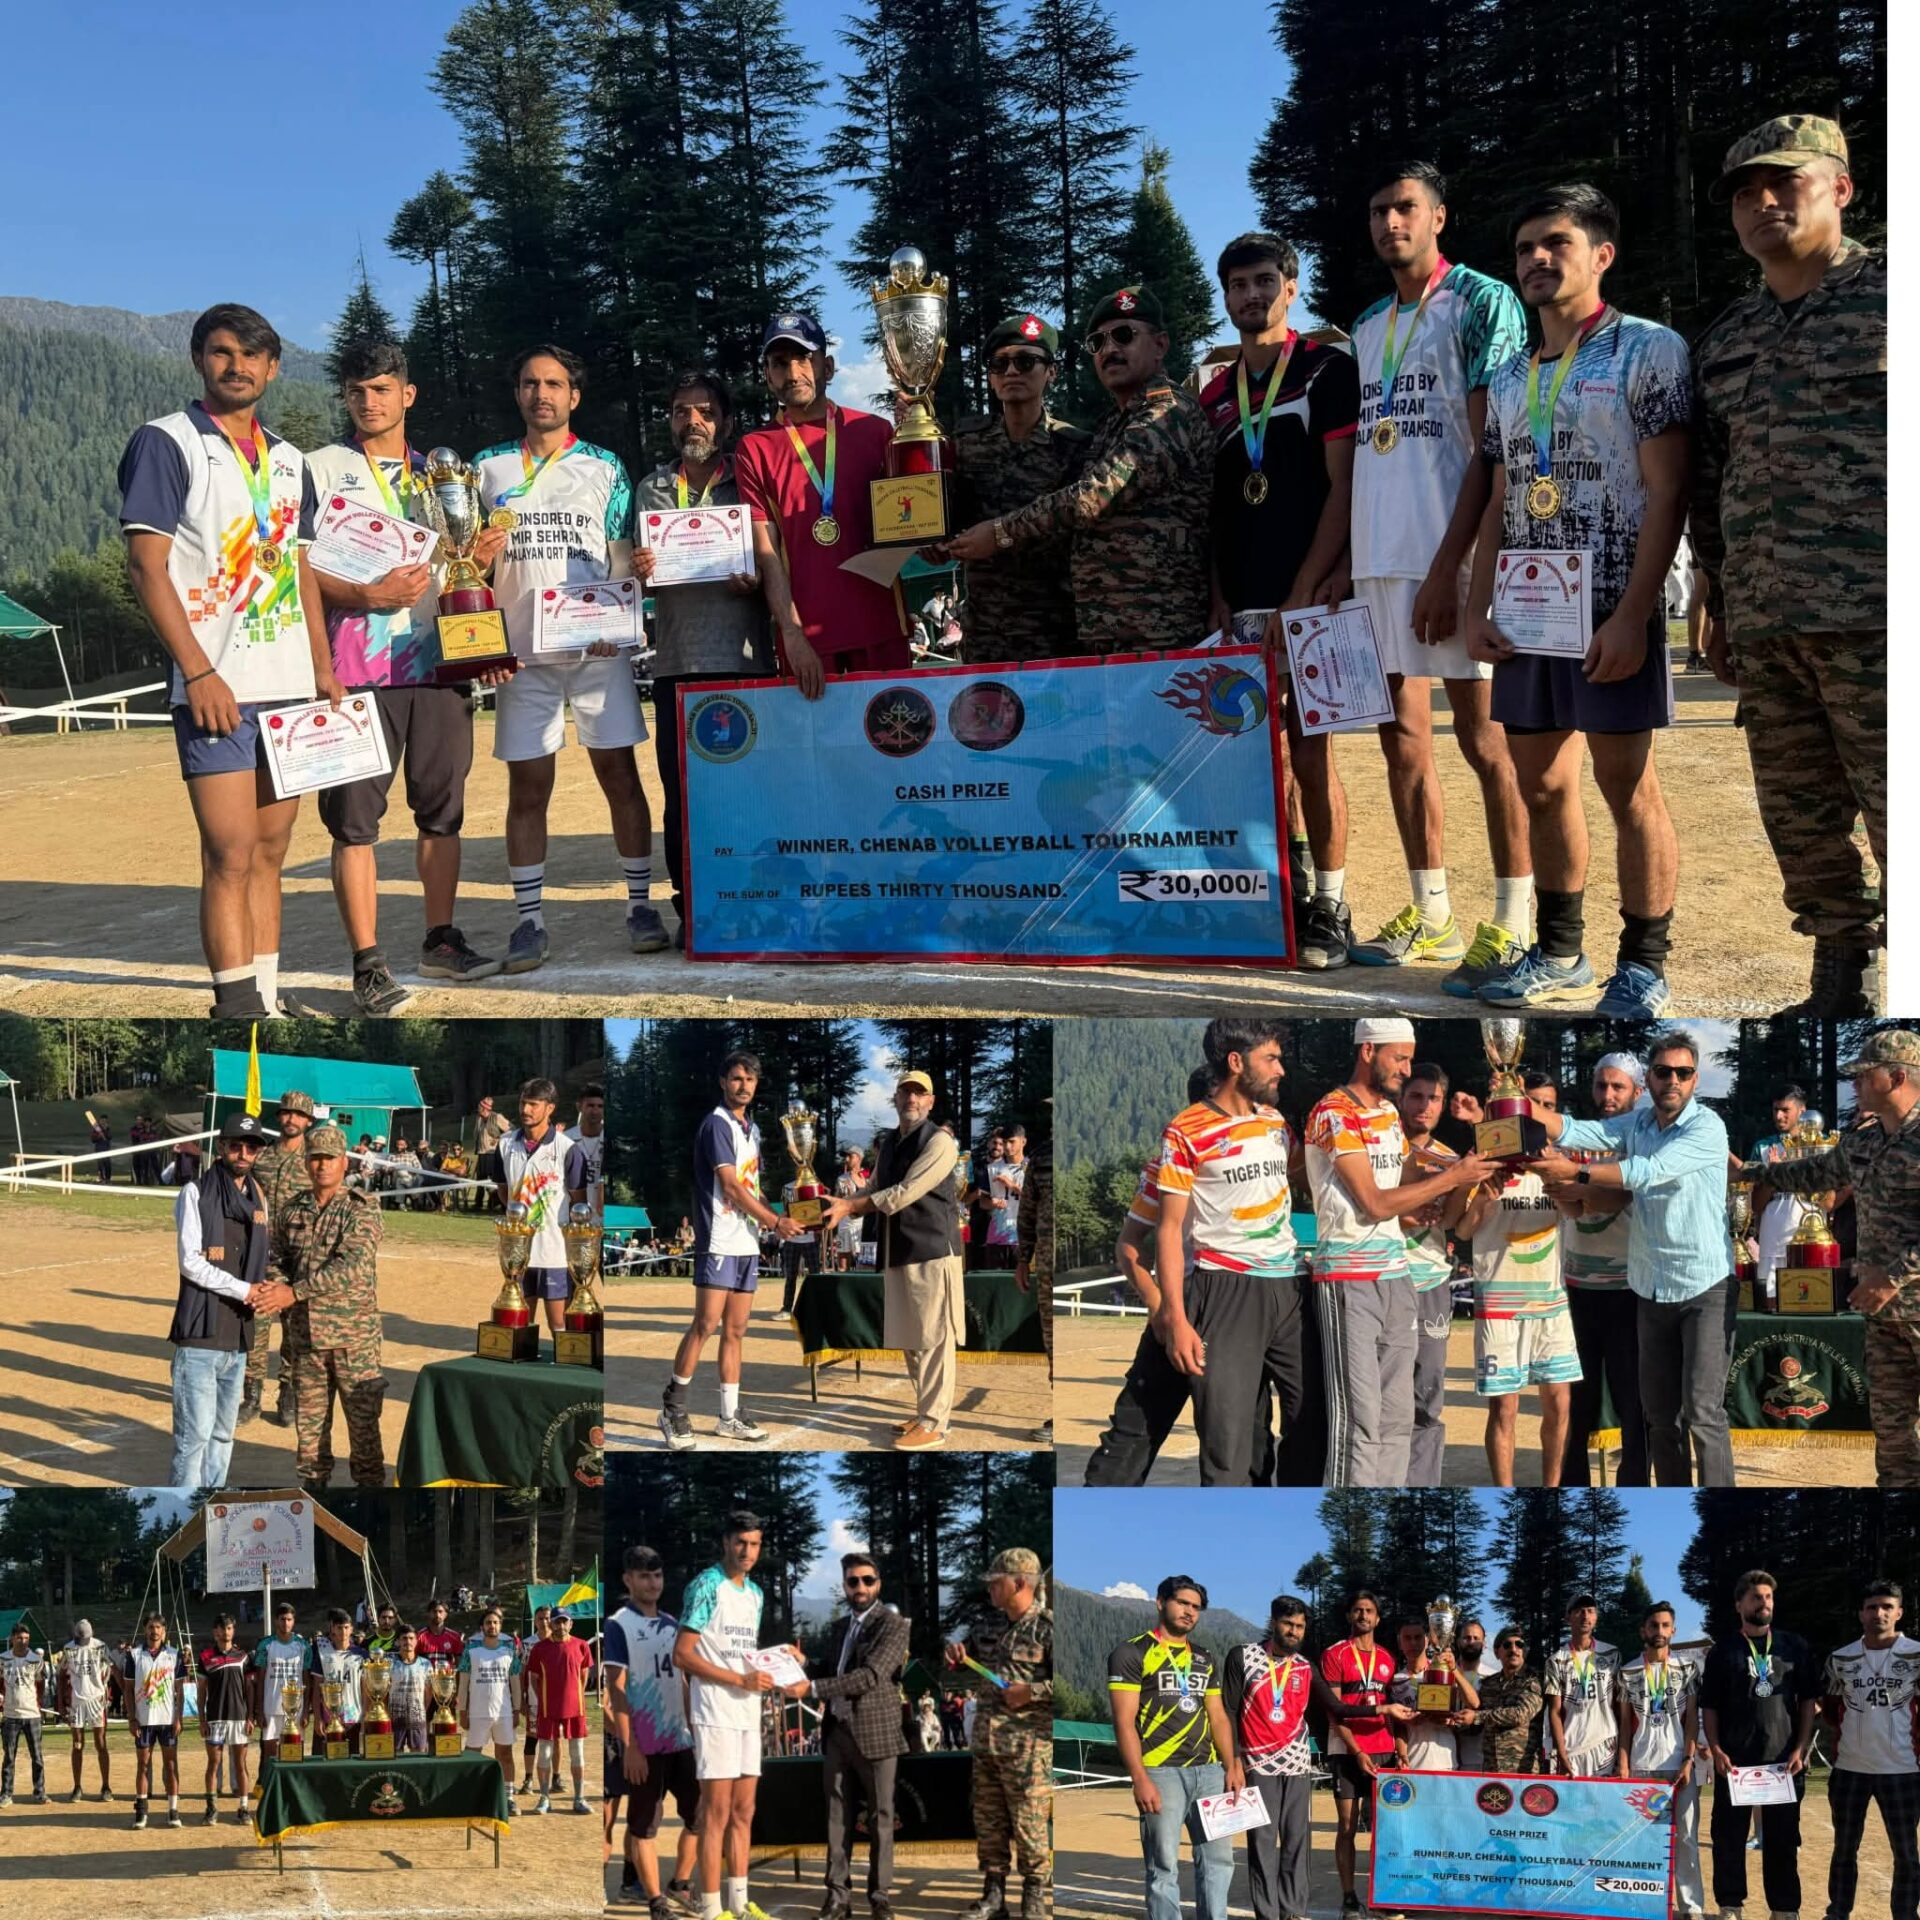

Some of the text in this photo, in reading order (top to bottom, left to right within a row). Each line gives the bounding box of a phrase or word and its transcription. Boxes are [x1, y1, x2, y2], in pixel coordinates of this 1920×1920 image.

[1363, 373, 1437, 401] ONSRED BY
[1376, 398, 1424, 420] SHRAN
[1558, 431, 1574, 451] BY
[1524, 461, 1602, 483] COTRUCTION
[517, 512, 592, 528] ONSORED BY
[511, 530, 583, 544] MIR SEHRAN
[504, 547, 543, 563] IMALAYAN
[895, 783, 1010, 801] CASH PRIZE
[714, 830, 1238, 856] PAY WINNER, CHENAB VOLLEYBALL TOURNAMENT
[718, 891, 737, 900] THE
[742, 890, 764, 899] SUM
[767, 889, 781, 899] OF
[801, 884, 871, 898] RUPEES
[877, 883, 944, 898] THIRTY
[951, 883, 1067, 899] THOUSAND.
[1223, 1162, 1261, 1184] TIGER
[1501, 1197, 1531, 1211] TIGER
[714, 1255, 724, 1271] 7
[1771, 1334, 1818, 1348] RASHTRIYA
[654, 1653, 675, 1678] 14
[1853, 1676, 1903, 1689] BLOCKER
[1866, 1688, 1889, 1707] 45
[1489, 1828, 1548, 1839] CASH PRIZE
[1413, 1850, 1472, 1860] RUNNER-UP,
[1475, 1853, 1516, 1862] CHENAB
[1519, 1855, 1586, 1866] VOLLEYBALL
[1588, 1858, 1663, 1870] TOURNAMENT
[1433, 1872, 1471, 1882] RUPEES
[1474, 1874, 1514, 1883] TWENTY
[1518, 1877, 1576, 1888] THOUSAND.
